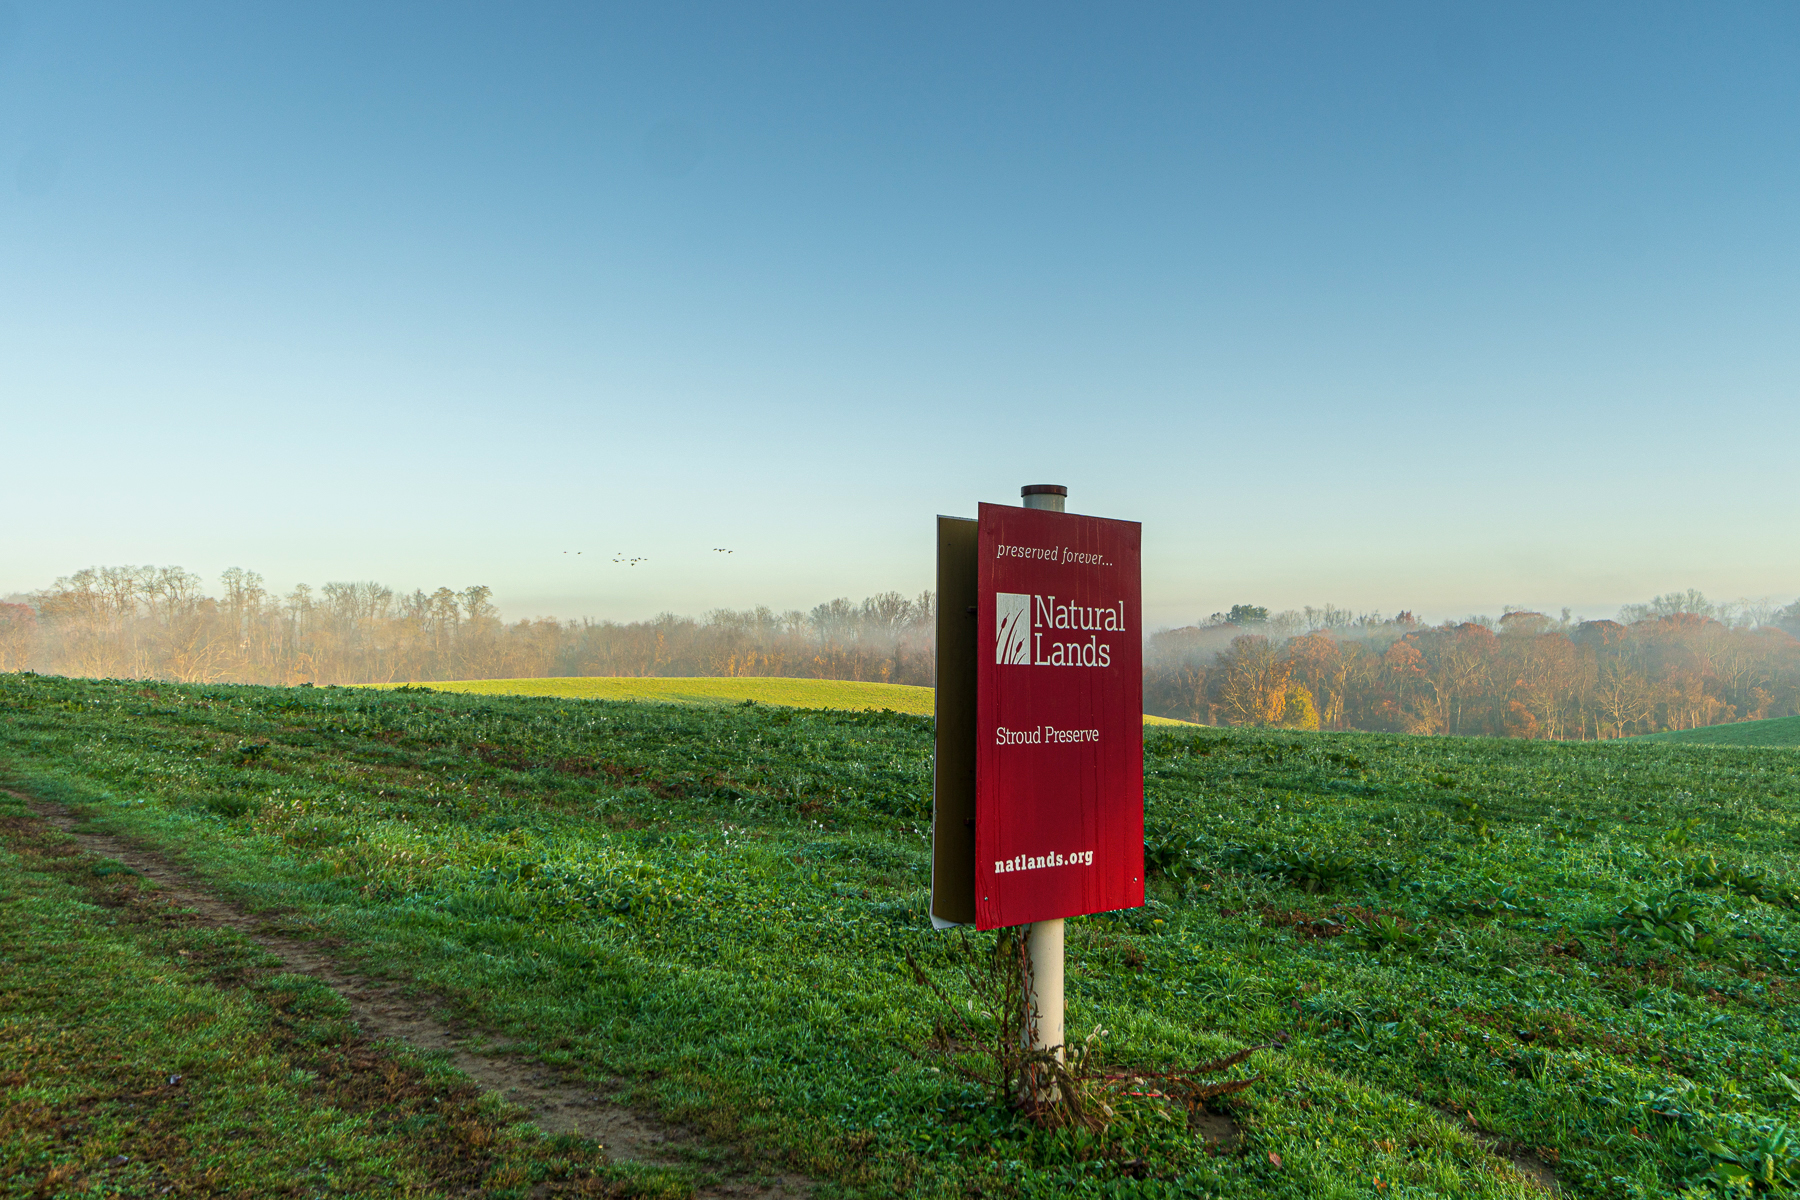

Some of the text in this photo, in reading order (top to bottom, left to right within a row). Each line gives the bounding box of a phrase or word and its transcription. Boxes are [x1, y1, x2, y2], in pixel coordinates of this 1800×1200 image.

[997, 544, 1113, 566] preserved forever...
[1034, 595, 1126, 632] Natural
[1034, 632, 1111, 667] Lands
[996, 725, 1099, 745] Stroud Preserve
[994, 850, 1094, 874] natlands.org
